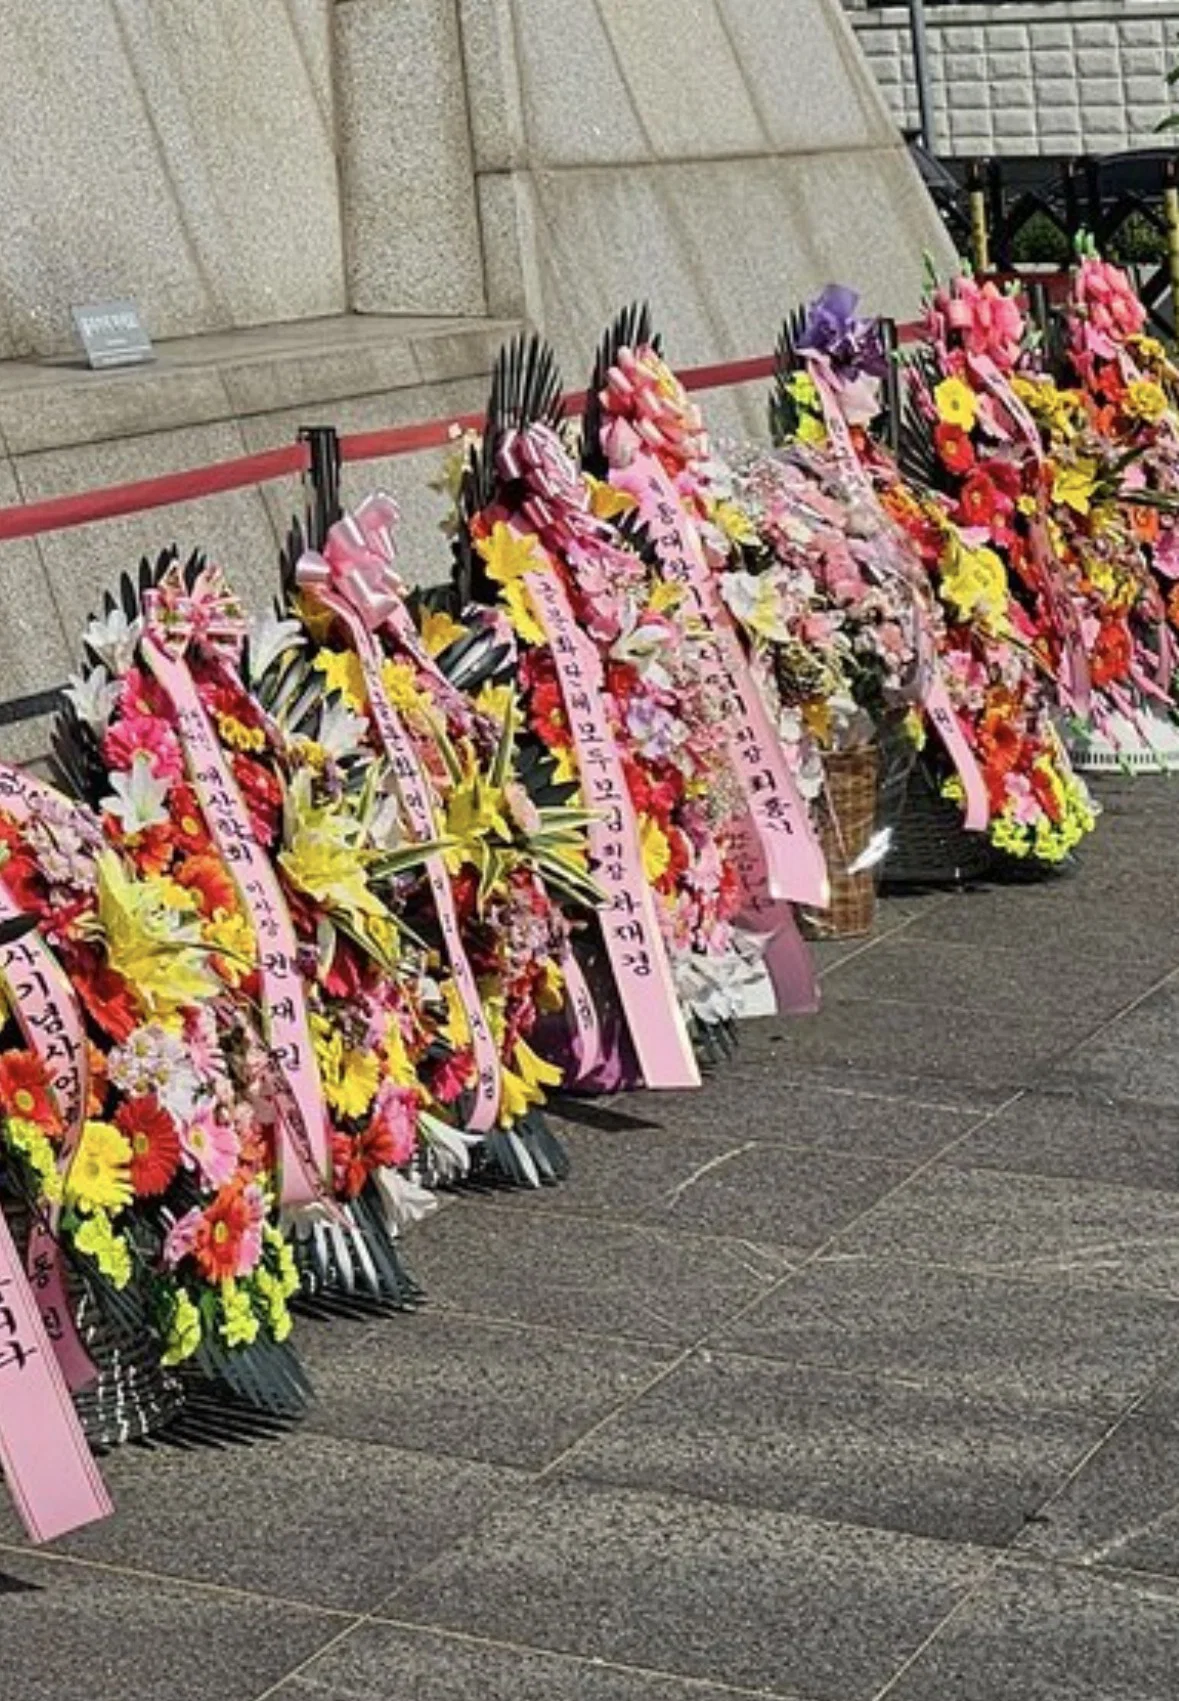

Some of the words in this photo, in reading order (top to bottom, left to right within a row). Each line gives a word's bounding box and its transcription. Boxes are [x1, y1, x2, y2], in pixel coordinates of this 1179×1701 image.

[734, 726, 763, 764] 회장
[602, 842, 627, 881] 회장
[245, 879, 279, 937] 이사장
[611, 887, 651, 977] 차재경
